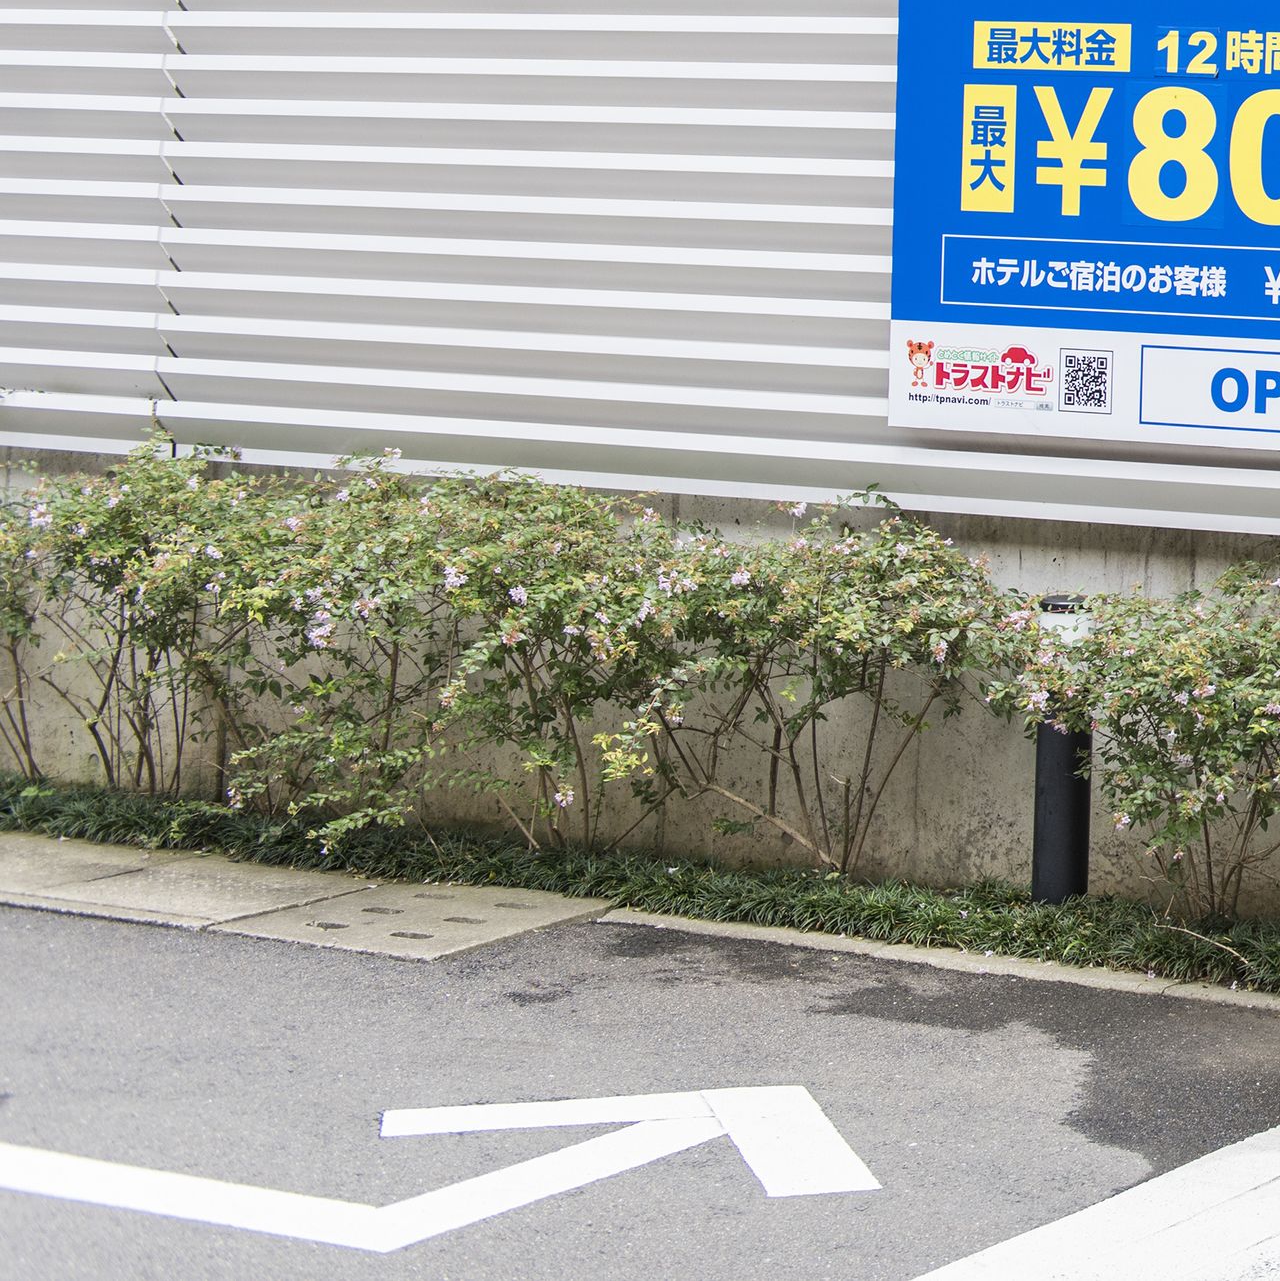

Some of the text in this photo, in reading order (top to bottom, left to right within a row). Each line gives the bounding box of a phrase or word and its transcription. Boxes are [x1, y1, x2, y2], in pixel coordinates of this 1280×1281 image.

[986, 28, 1117, 66] 最大料金
[970, 105, 1007, 192] 最大
[971, 257, 1226, 298] ホテルご宿泊のお客様
[935, 361, 1050, 392] トラストナビ
[908, 392, 991, 407] http://tpnavi.com/
